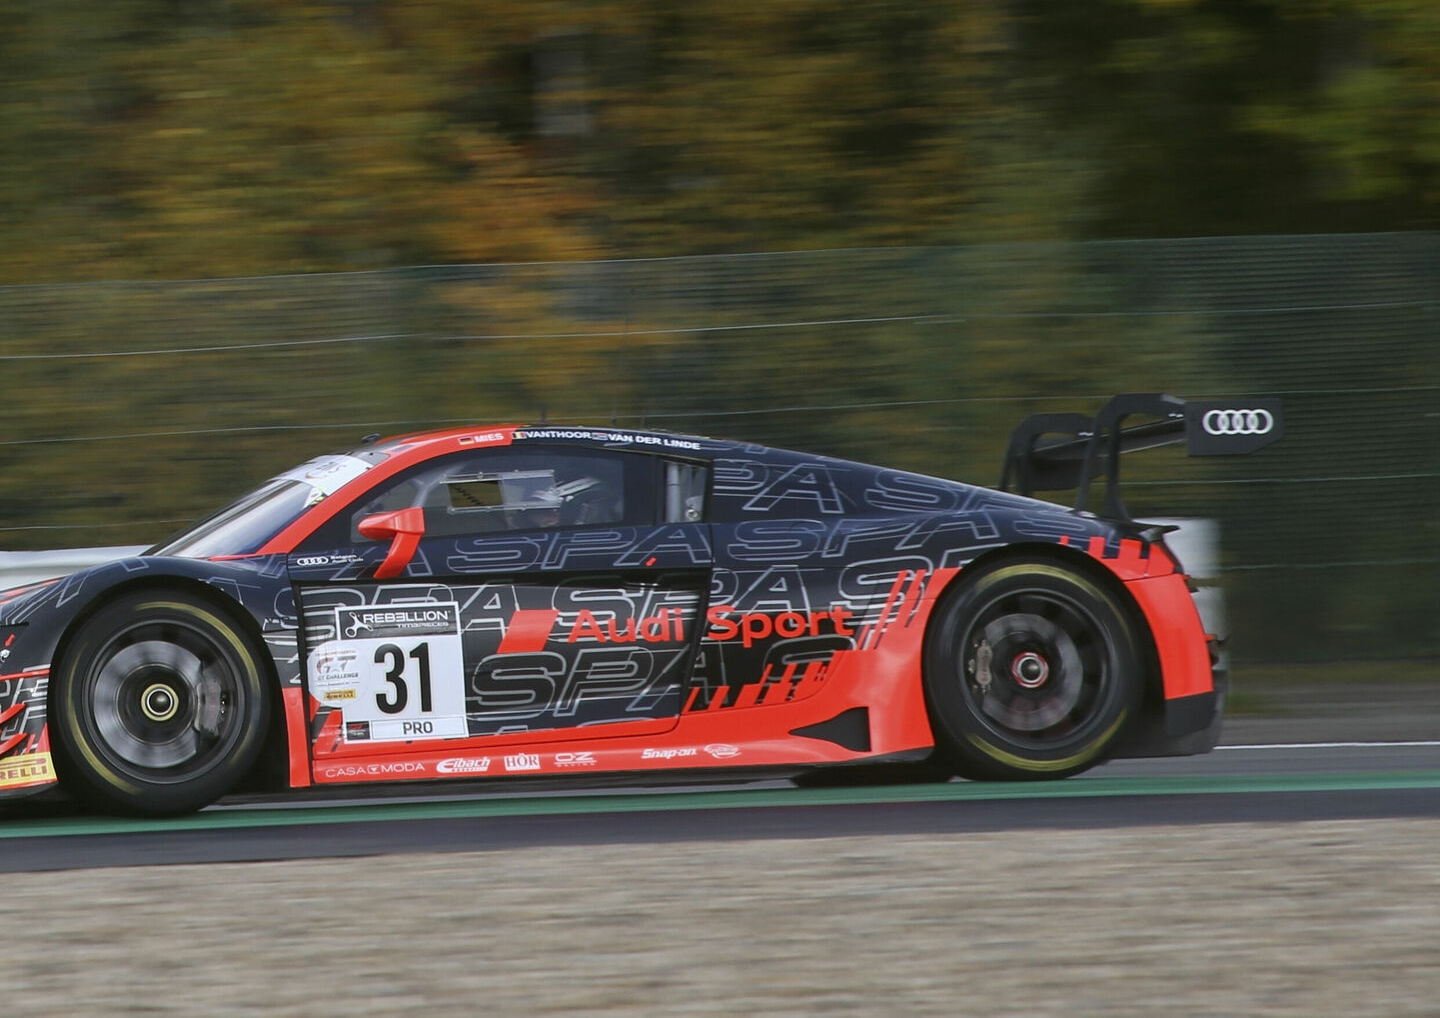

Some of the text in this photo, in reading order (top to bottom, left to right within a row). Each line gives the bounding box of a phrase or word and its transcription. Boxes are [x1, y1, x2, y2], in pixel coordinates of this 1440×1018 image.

[474, 433, 504, 443] MIES
[525, 430, 592, 440] VANTHOOR
[607, 433, 633, 443] VAN
[635, 435, 662, 445] DER
[663, 438, 701, 450] LINDE
[446, 523, 713, 574] SPA
[567, 604, 853, 648] Audi Sport
[374, 642, 433, 714] 31
[403, 721, 433, 735] PRO
[641, 748, 696, 759] Snap-on
[325, 762, 425, 778] CASA MODA
[436, 756, 491, 773] Eibach
